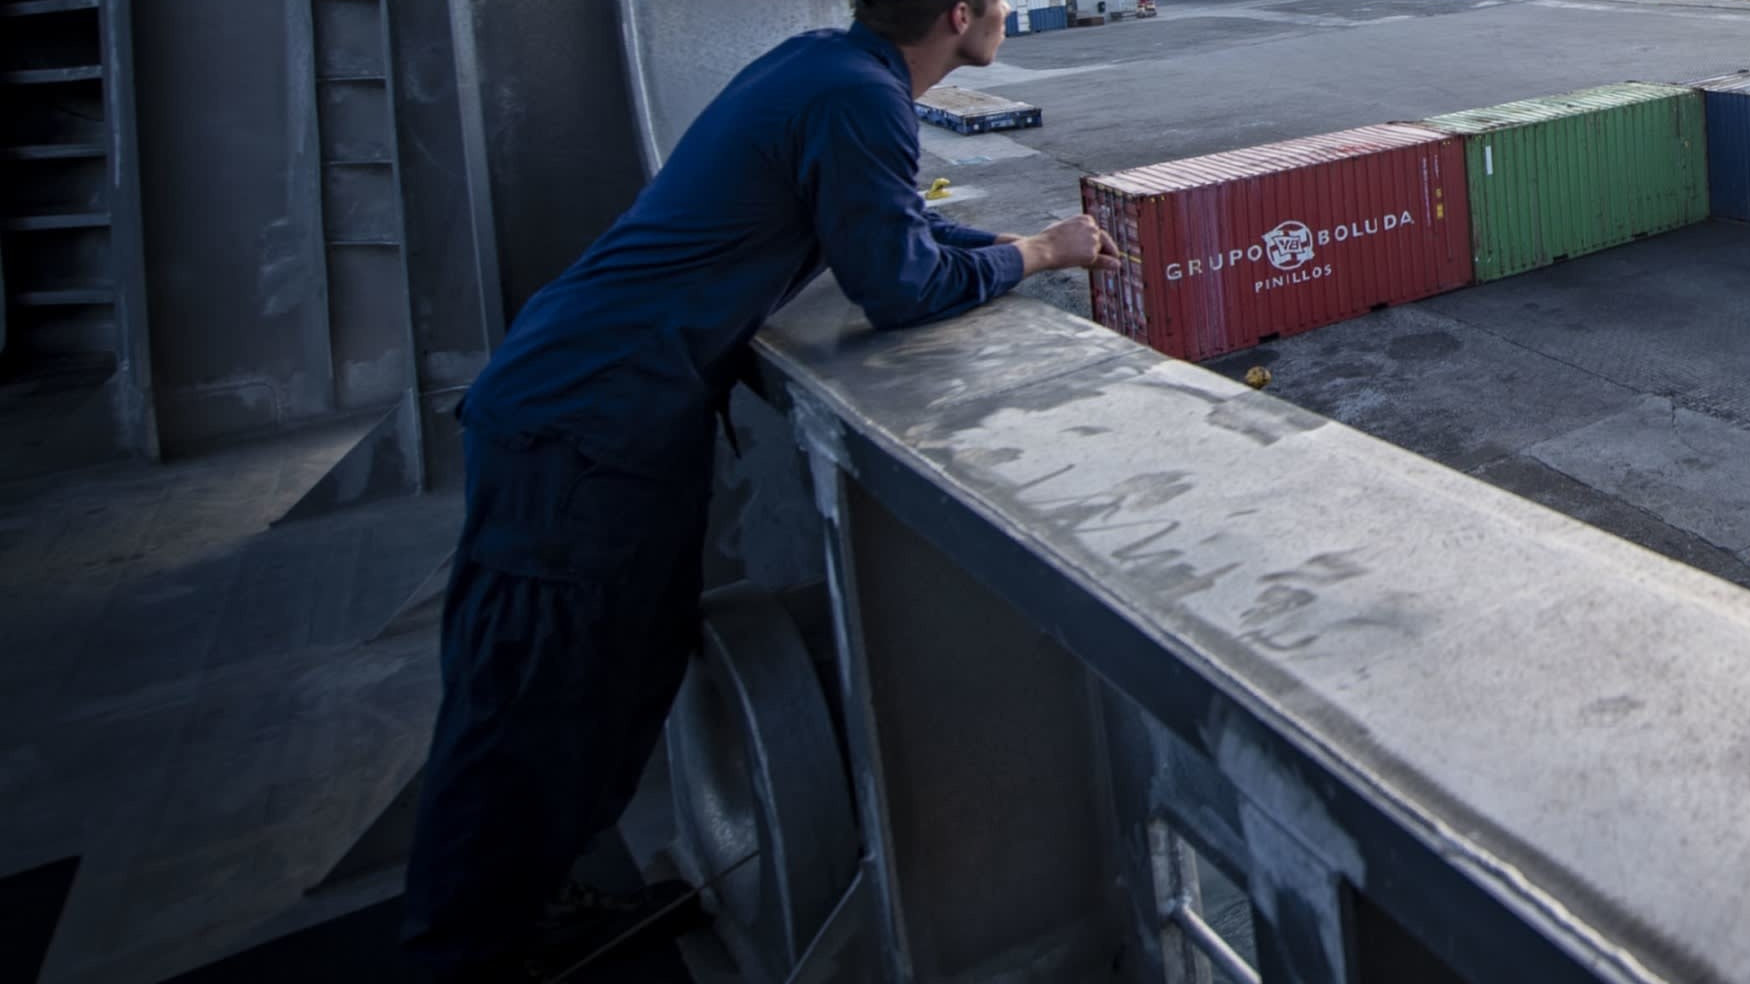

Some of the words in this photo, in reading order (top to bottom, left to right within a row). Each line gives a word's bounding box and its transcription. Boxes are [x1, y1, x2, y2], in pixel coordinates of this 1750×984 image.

[1166, 244, 1262, 281] GRUPO
[1317, 210, 1415, 246] BOLUDA
[1254, 263, 1332, 293] PINILLOS
